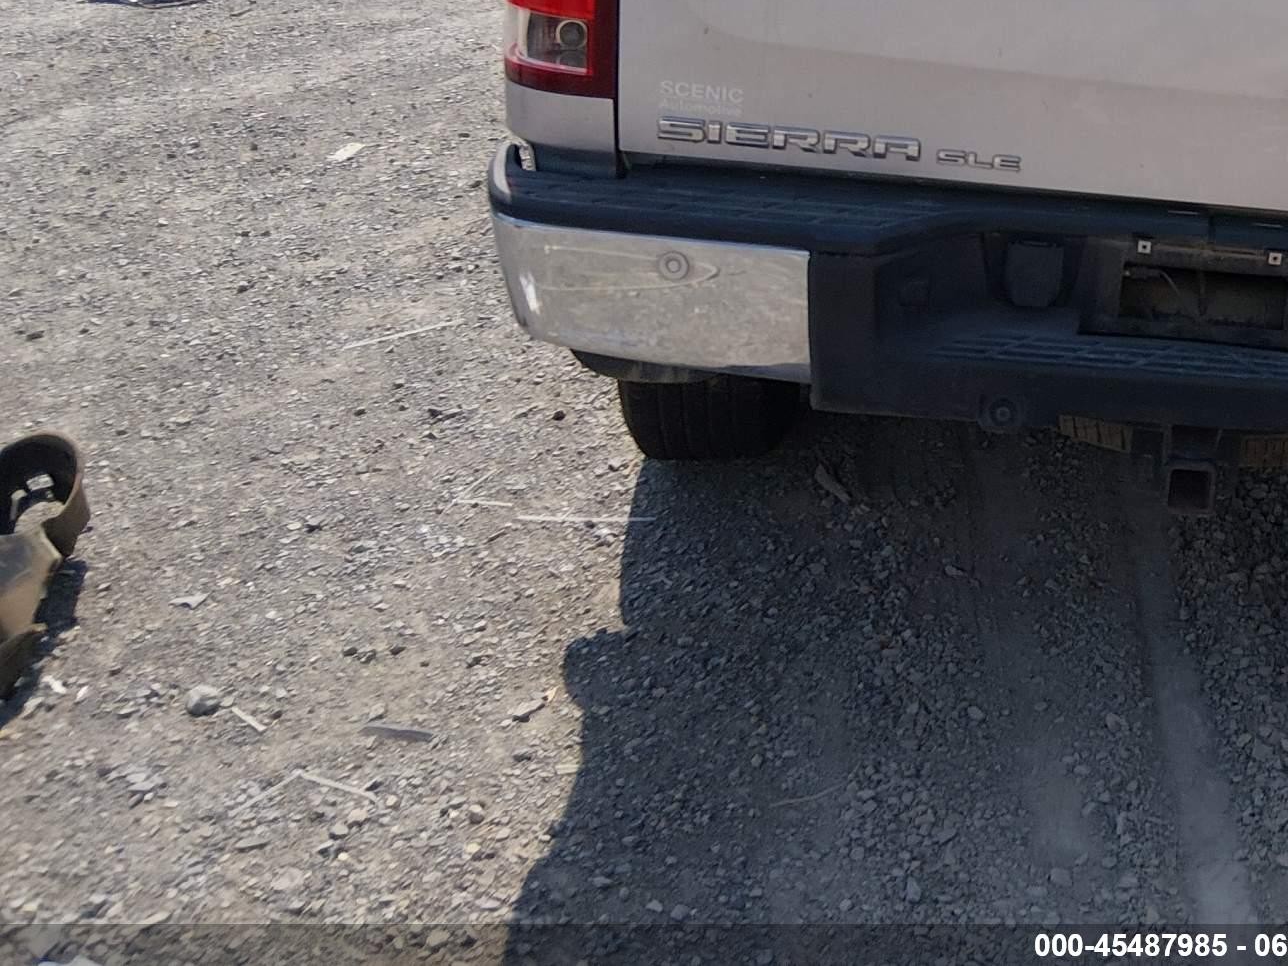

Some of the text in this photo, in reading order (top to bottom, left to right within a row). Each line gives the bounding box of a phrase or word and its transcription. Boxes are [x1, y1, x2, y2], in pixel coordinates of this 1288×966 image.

[660, 79, 744, 104] SCENIC
[656, 115, 1022, 172] SIERRA SLE
